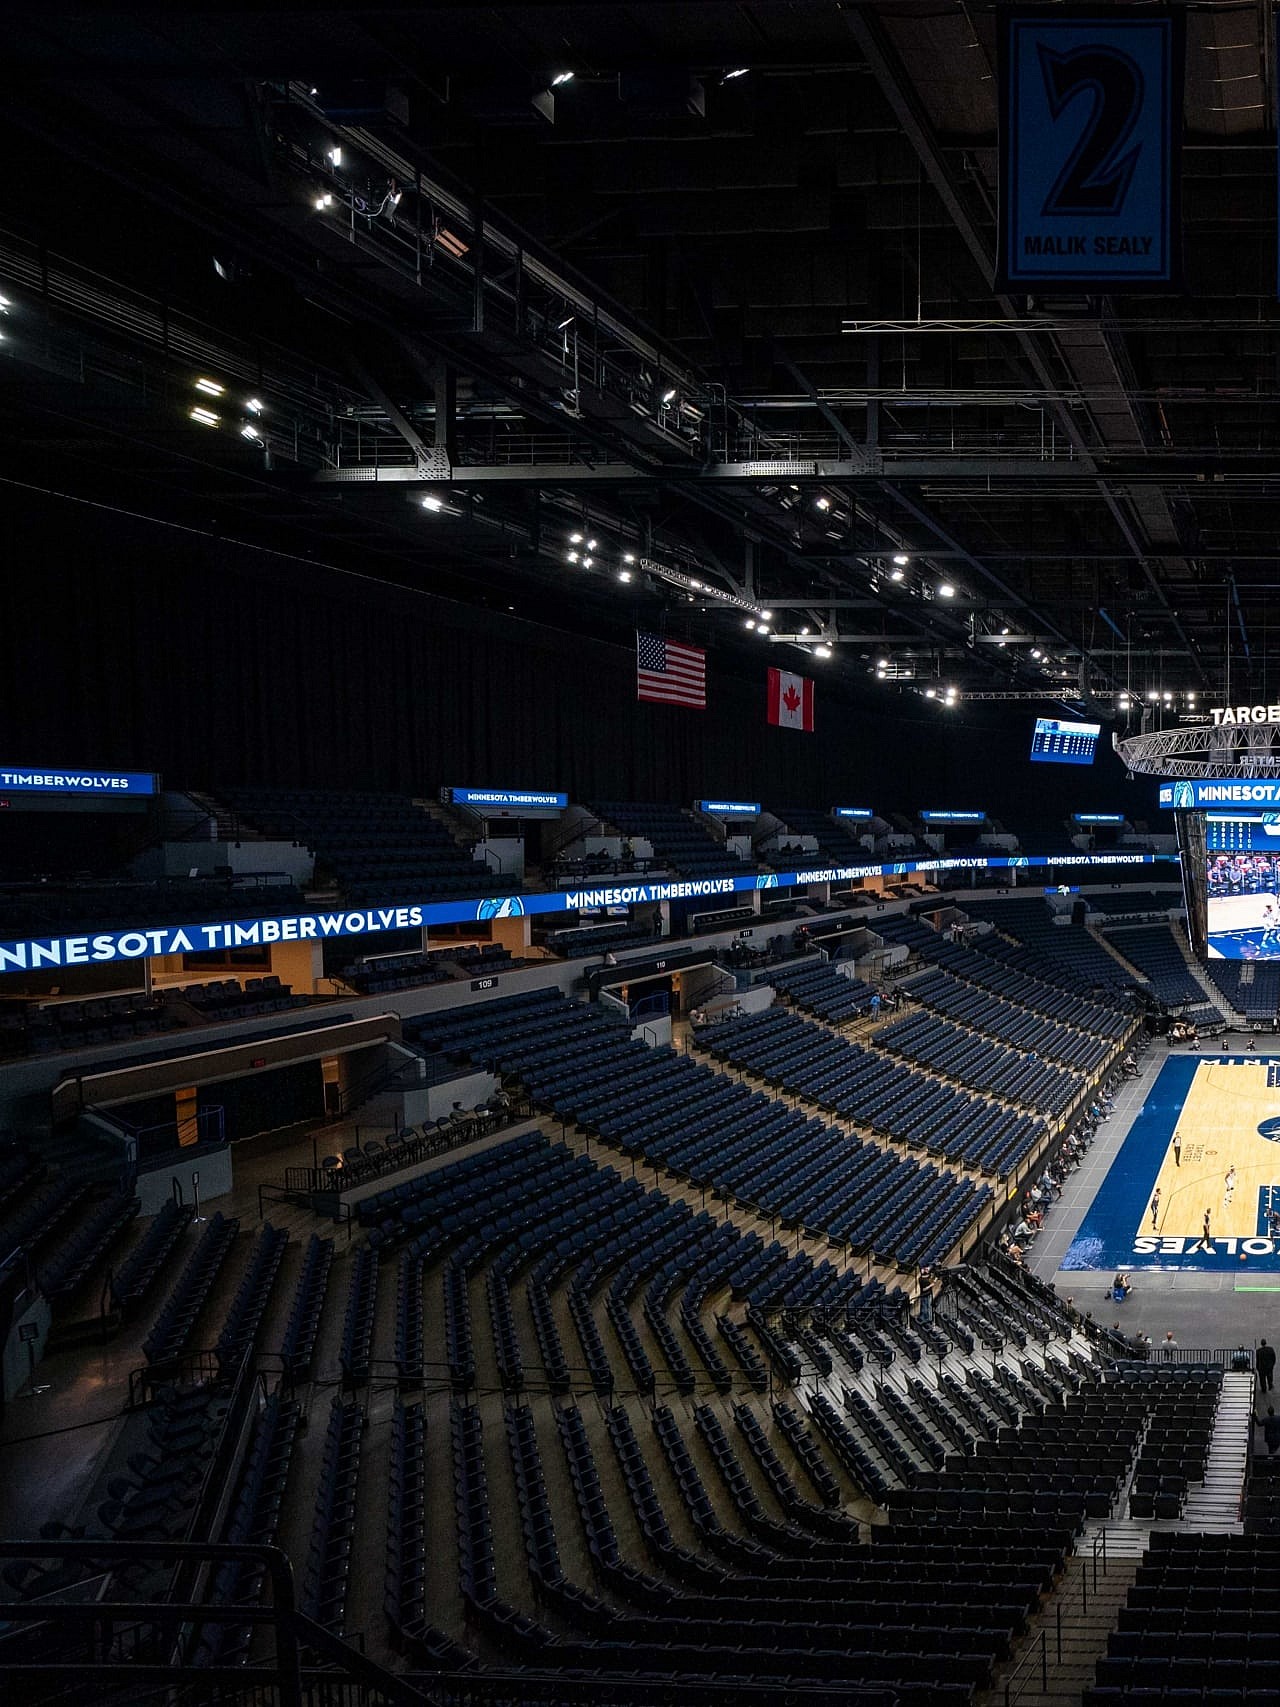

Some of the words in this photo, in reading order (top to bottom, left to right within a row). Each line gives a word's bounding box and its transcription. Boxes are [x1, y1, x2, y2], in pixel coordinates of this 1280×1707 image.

[1036, 42, 1144, 216] 2
[1024, 236, 1087, 256] MALIK
[1093, 236, 1153, 256] SEALY
[1, 773, 129, 789] TIMBERWOLVES
[468, 793, 508, 802] MINNESOTA
[509, 795, 558, 804] TIMBERWOLVES
[1047, 857, 1090, 865] MINNESOTA
[1091, 855, 1144, 864] TIMBERWOLVES
[797, 869, 837, 884] MINNESOTA
[566, 889, 647, 909] MINNESOTA
[649, 879, 734, 900] TIMBERWOLVES
[202, 906, 423, 948] TIMBERWOLVES
[656, 960, 666, 969] 110
[479, 979, 492, 989] 109
